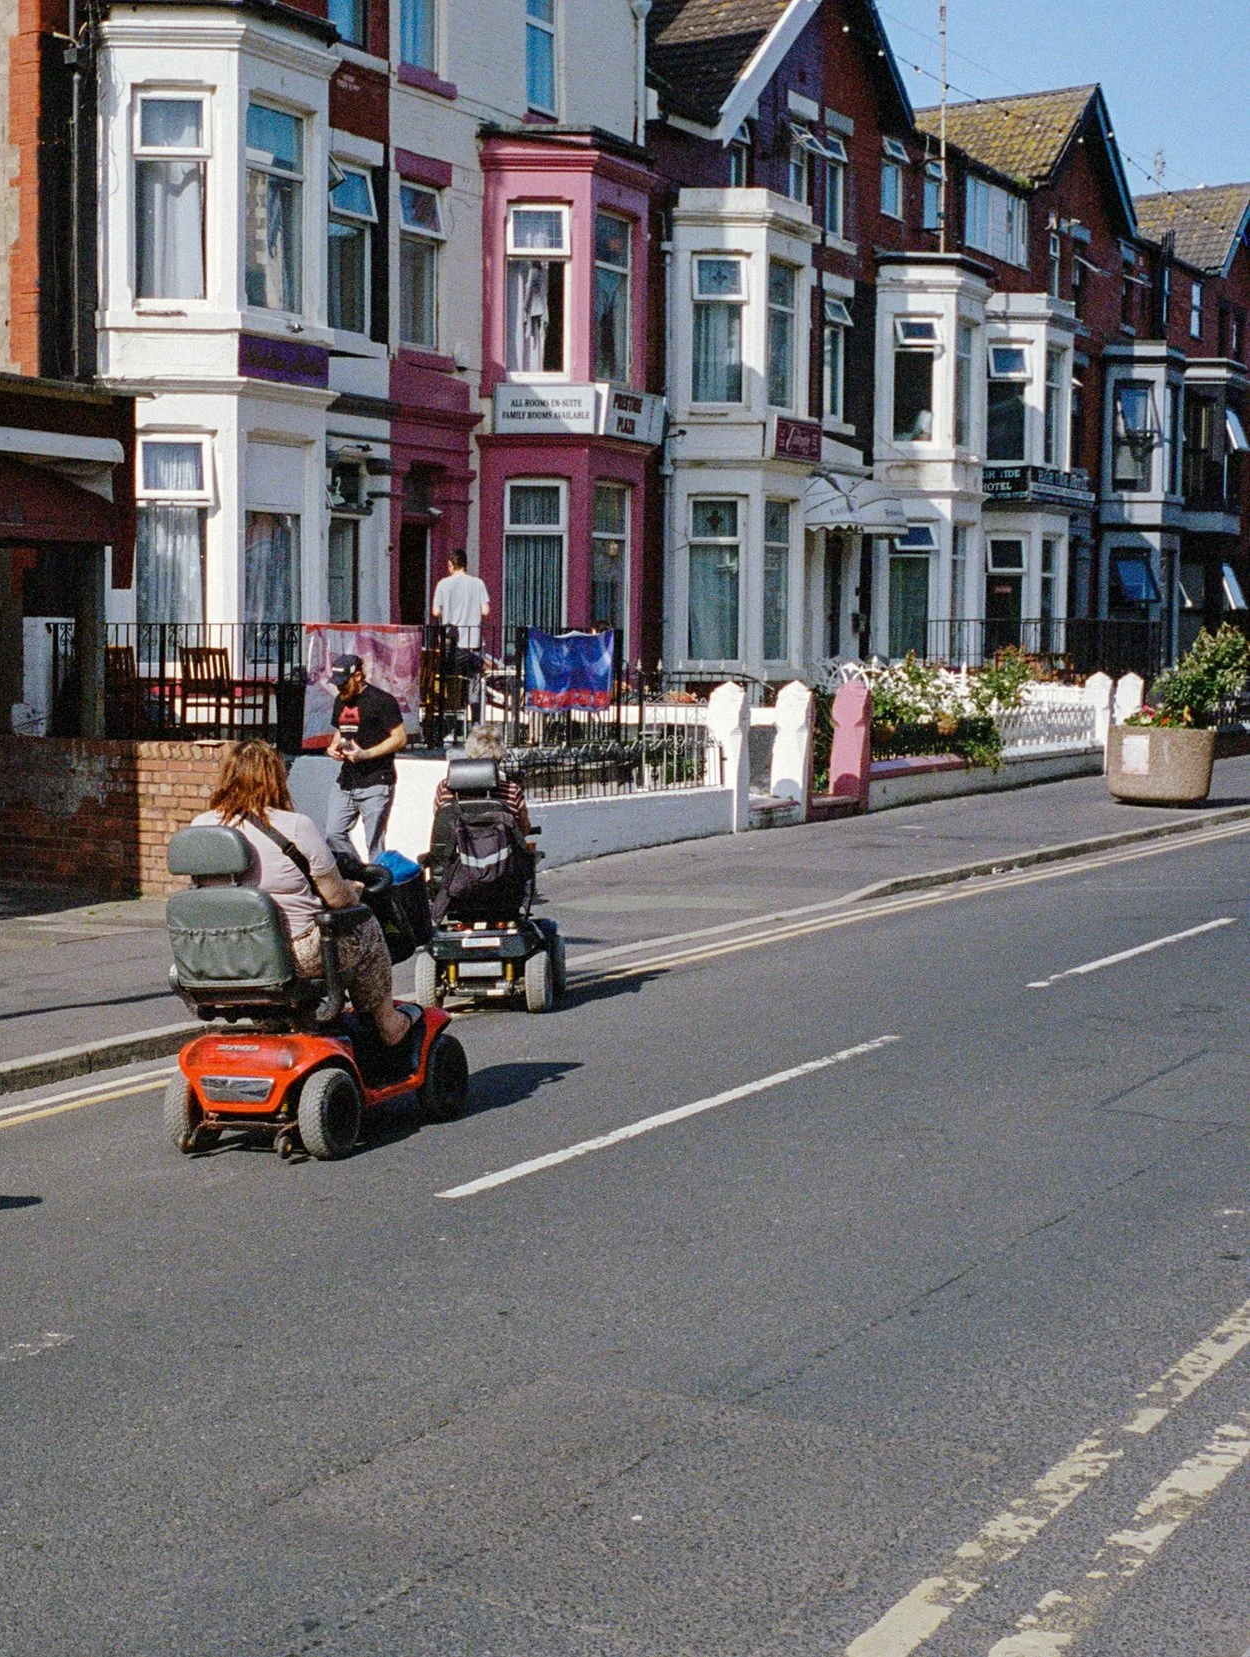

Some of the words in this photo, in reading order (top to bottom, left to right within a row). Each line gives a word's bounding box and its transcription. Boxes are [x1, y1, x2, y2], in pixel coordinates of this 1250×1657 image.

[511, 399, 523, 407] ALL
[525, 399, 549, 407] ROOMS
[502, 411, 527, 420] FAMILY
[528, 411, 552, 420] ROOMS
[553, 411, 590, 420] AVAILABLE
